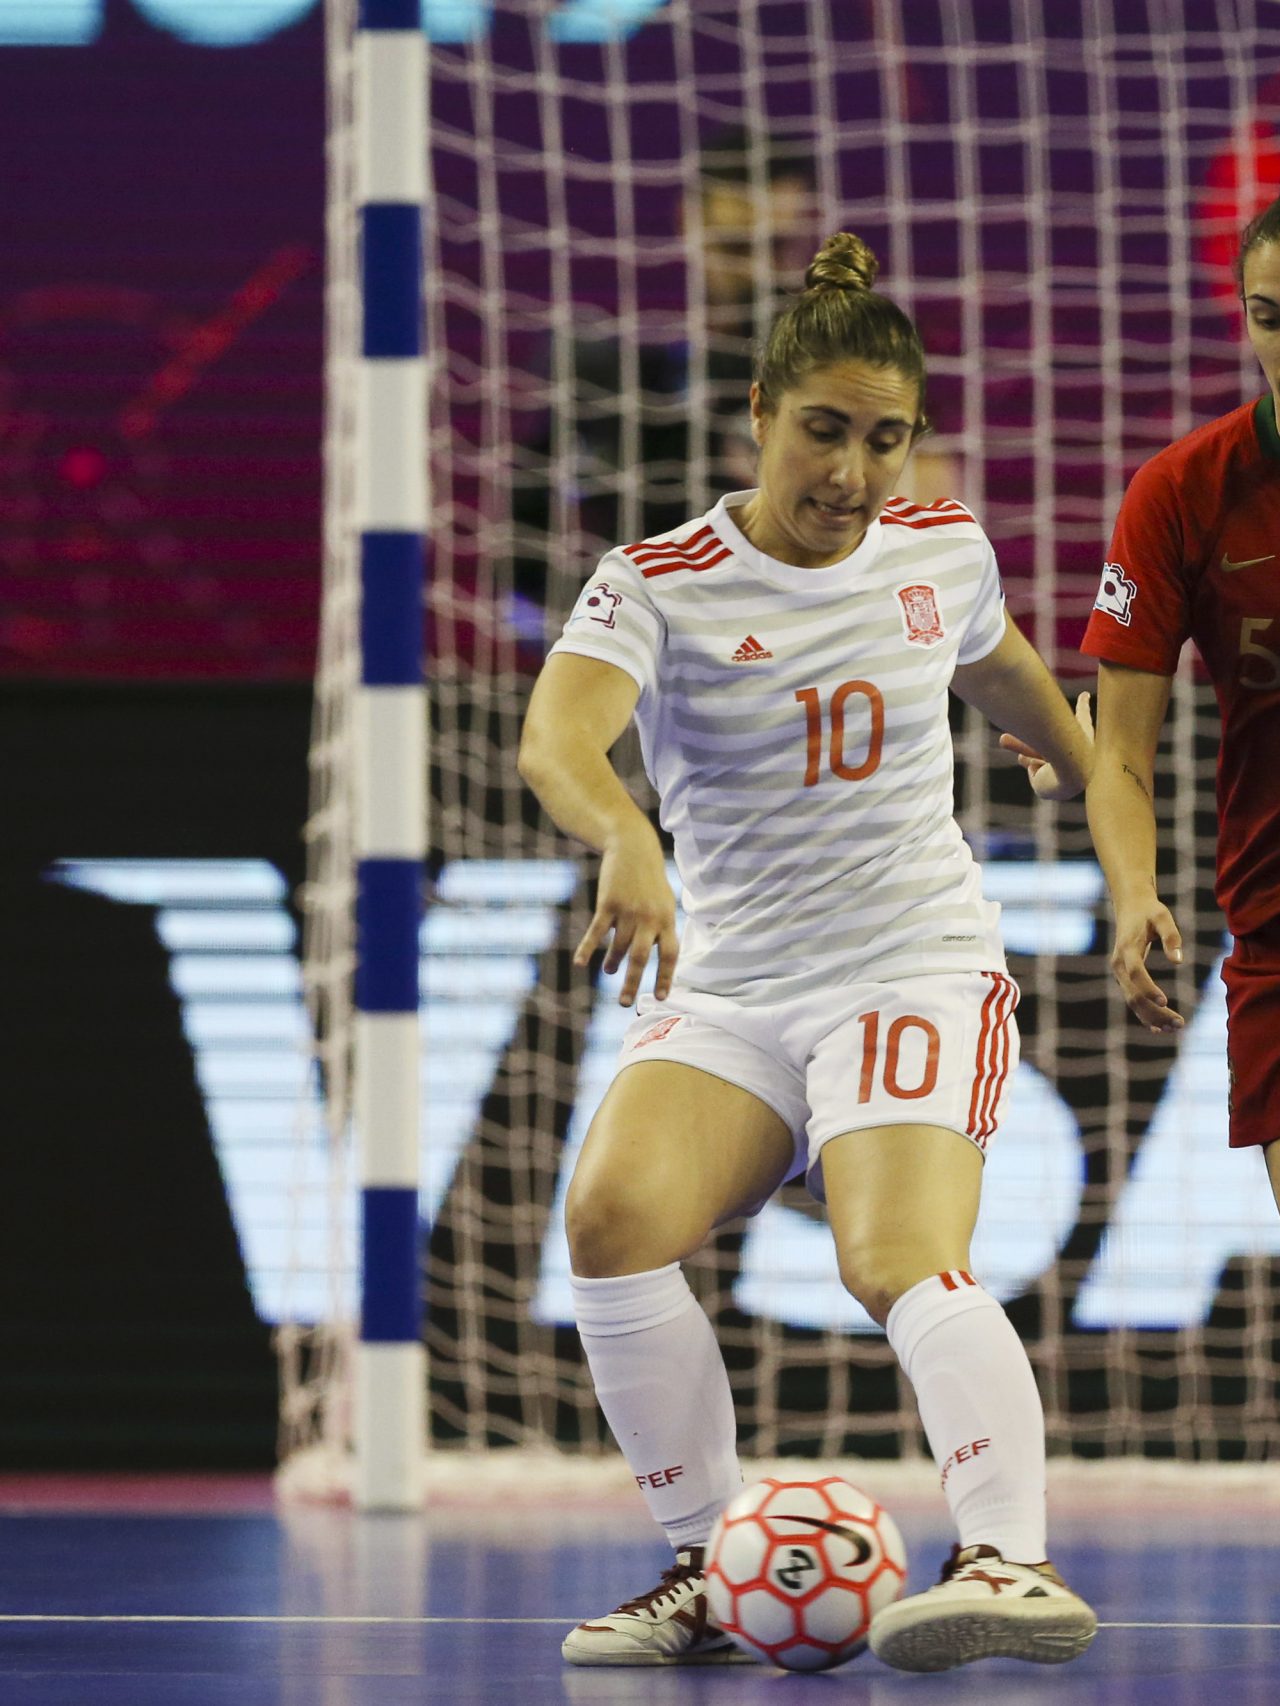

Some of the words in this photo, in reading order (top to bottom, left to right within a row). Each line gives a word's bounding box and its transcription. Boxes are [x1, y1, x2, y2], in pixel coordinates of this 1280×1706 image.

[731, 650, 774, 662] adidas
[795, 680, 885, 788] 10
[858, 1010, 940, 1105] 10
